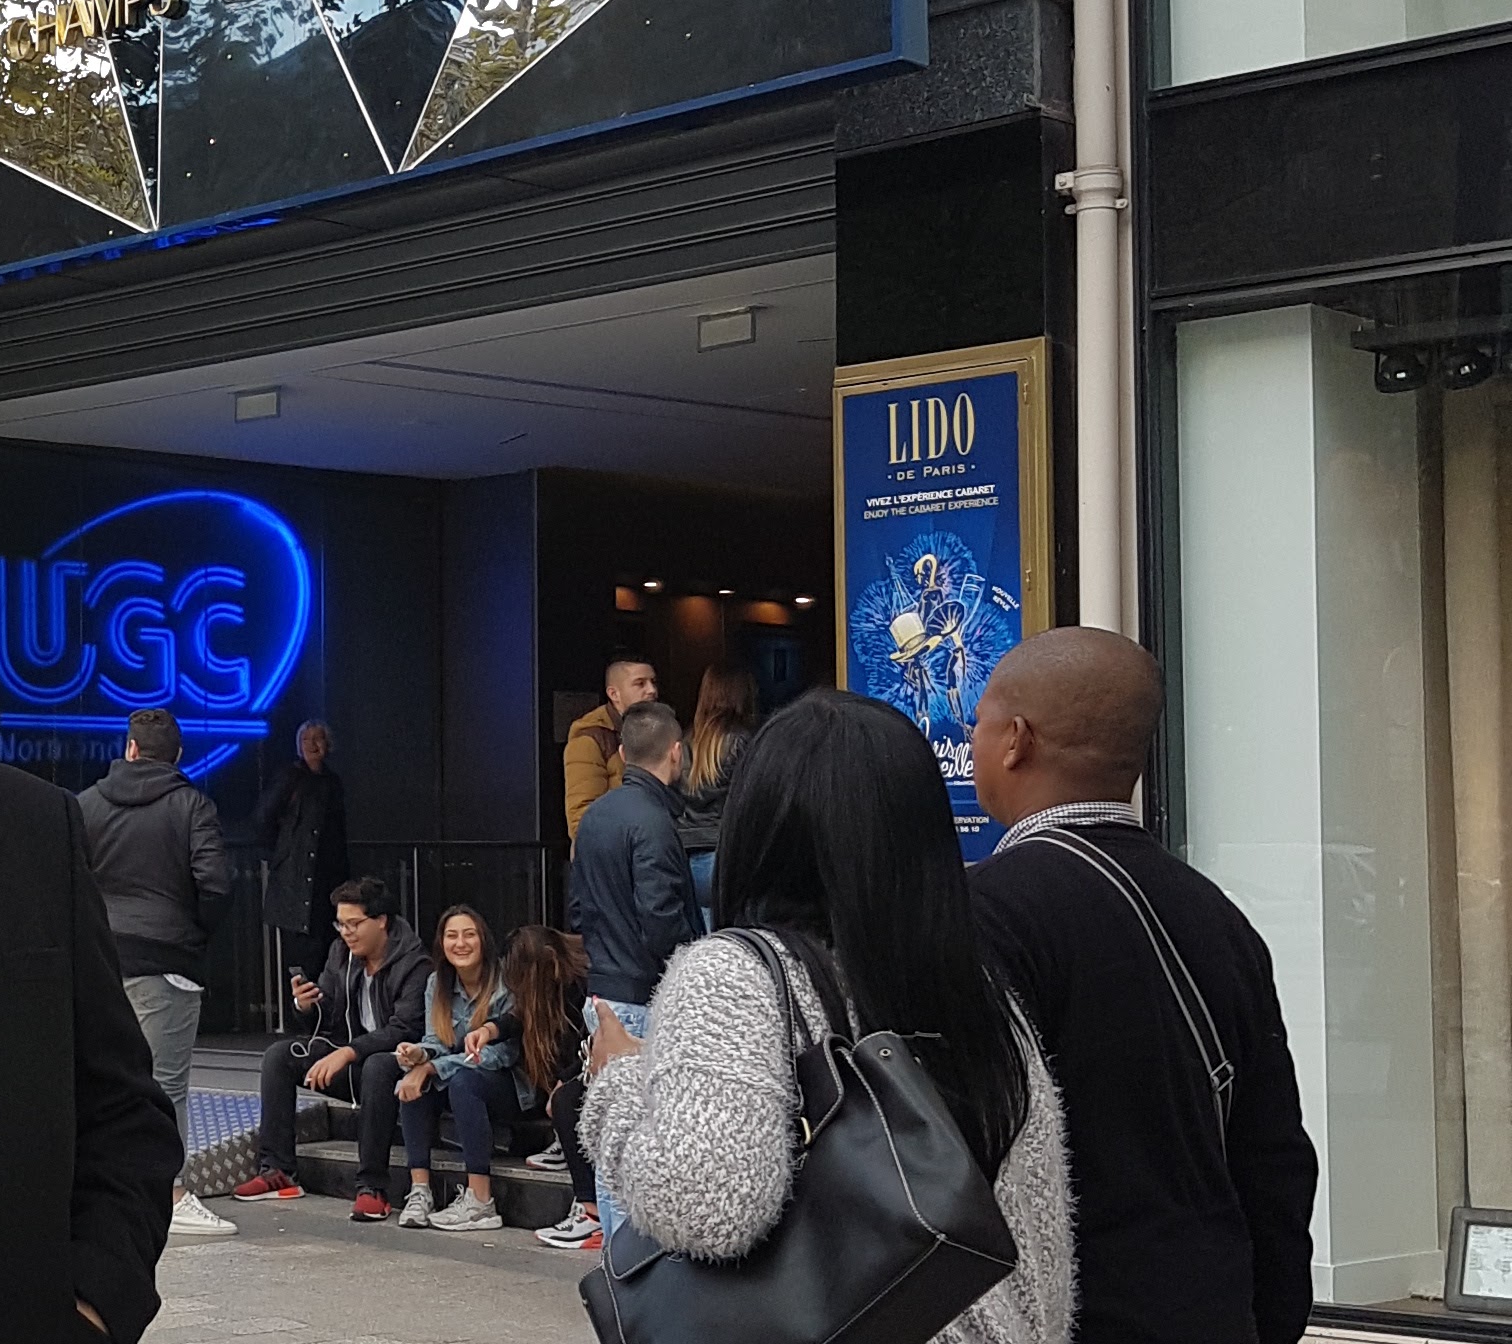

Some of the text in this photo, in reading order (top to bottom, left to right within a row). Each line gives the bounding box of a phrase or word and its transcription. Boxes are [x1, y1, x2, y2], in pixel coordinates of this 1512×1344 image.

[888, 392, 976, 465] LIDO
[866, 496, 892, 507] VIVEZ
[955, 484, 996, 498] CABARET
[864, 496, 999, 520] ENJOY THE CABARET EXPERIENCE
